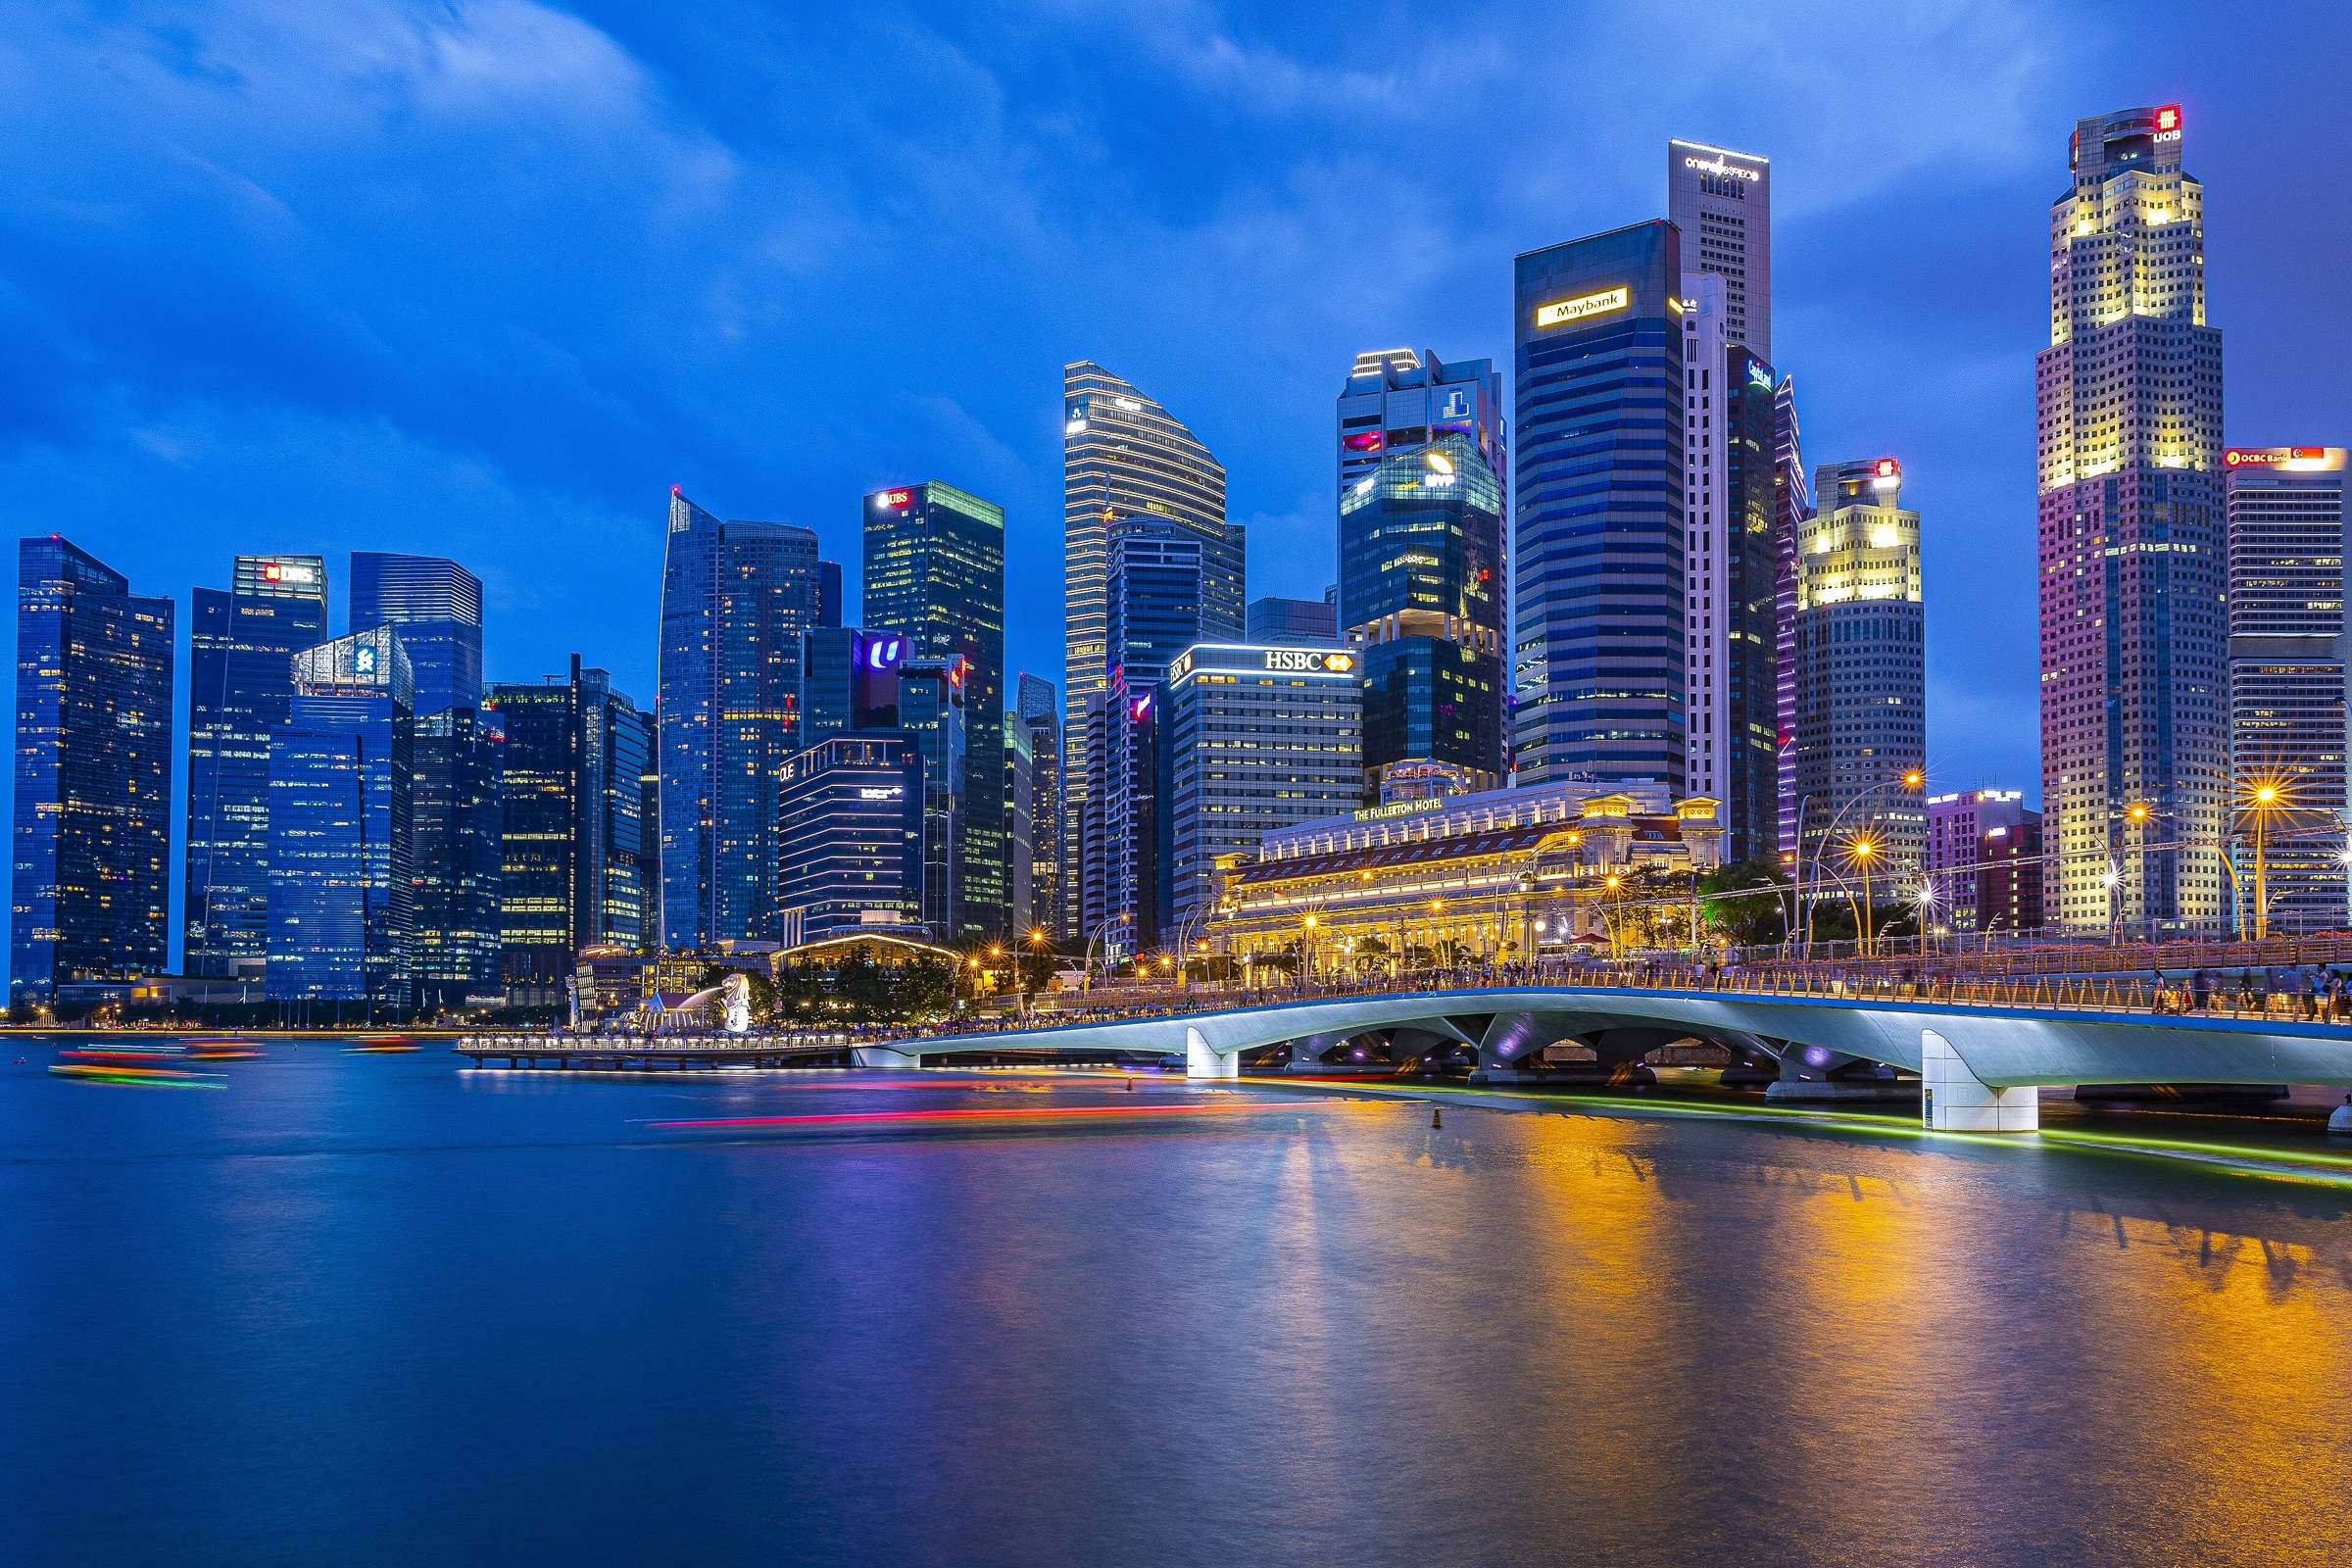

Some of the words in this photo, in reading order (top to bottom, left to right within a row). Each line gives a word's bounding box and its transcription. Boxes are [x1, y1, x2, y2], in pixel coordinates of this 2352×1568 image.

[2153, 129, 2181, 143] UOB
[1556, 293, 1619, 318] Maybank
[2240, 454, 2267, 463] OCBC
[2267, 453, 2288, 464] Bank
[889, 492, 908, 505] UBS
[1265, 651, 1322, 670] HSBC
[1170, 657, 1185, 684] HSBC
[779, 763, 795, 782] OUE
[1353, 809, 1369, 821] THE
[1370, 803, 1413, 819] FULLERTON
[1415, 798, 1443, 811] HOTEL
